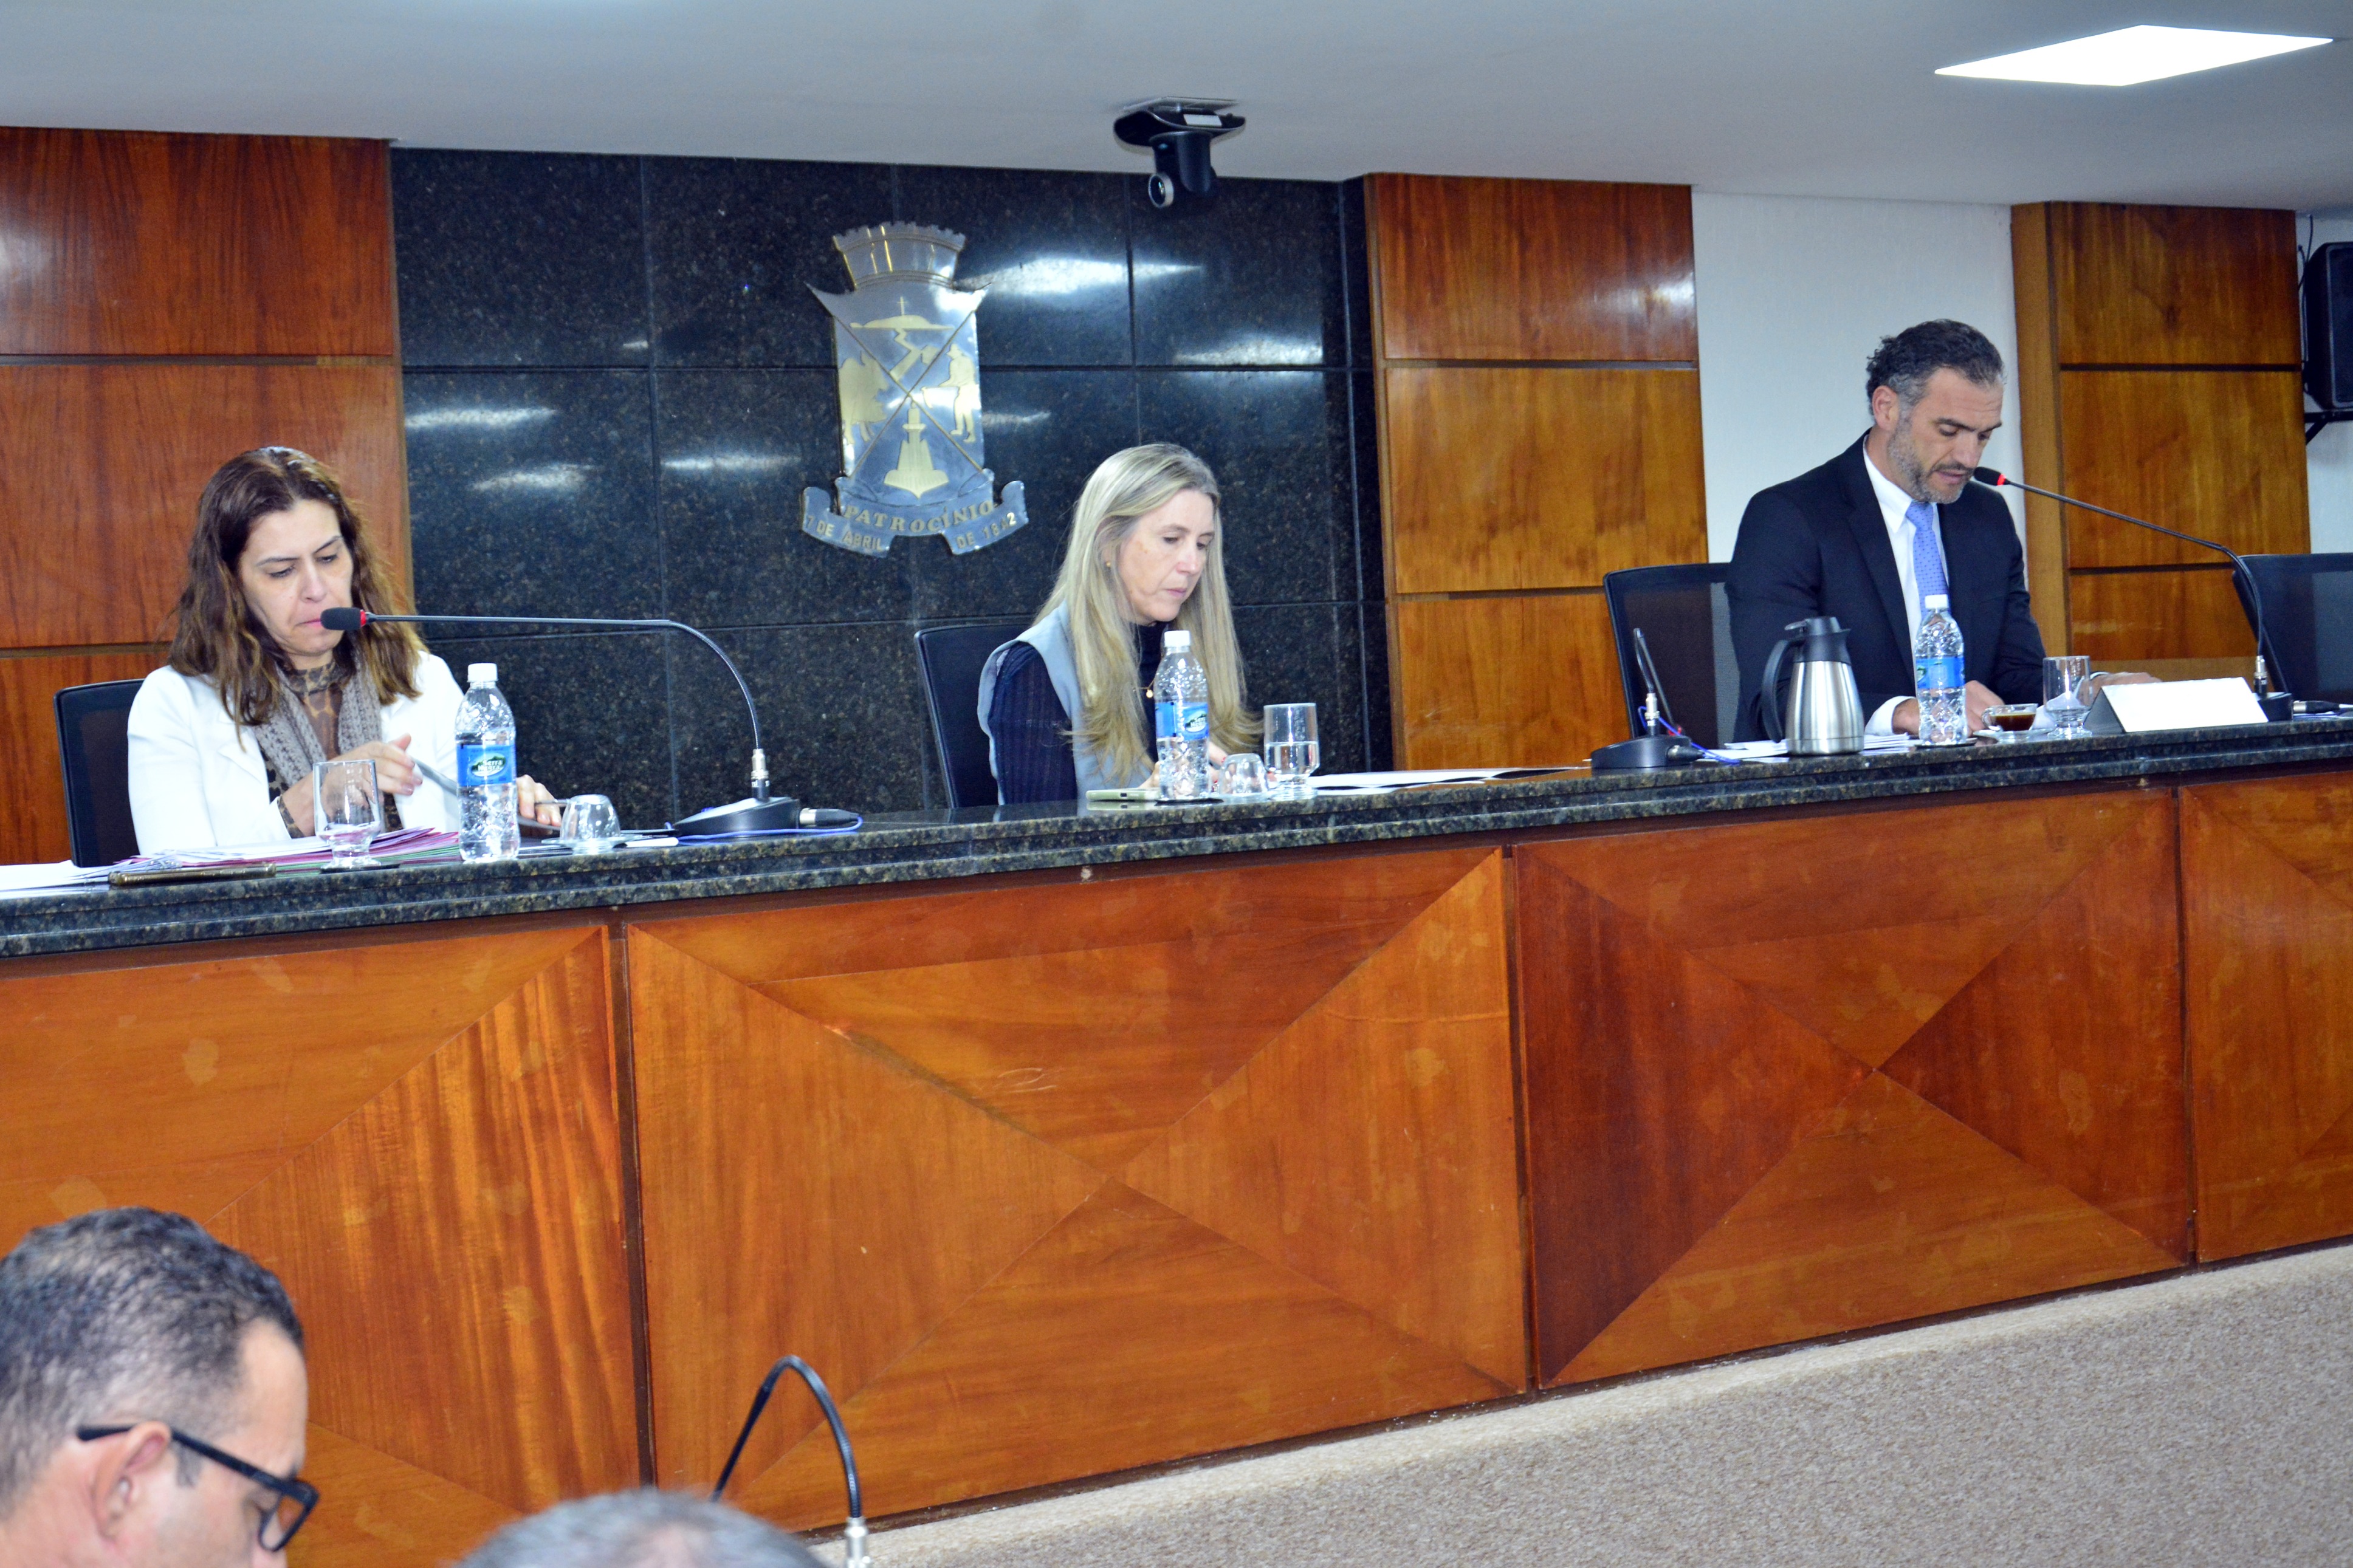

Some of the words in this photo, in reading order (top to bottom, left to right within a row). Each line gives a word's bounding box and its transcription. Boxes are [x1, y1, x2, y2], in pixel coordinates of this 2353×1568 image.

[843, 499, 993, 532] PATROCÍNIO
[806, 515, 814, 529] 7
[816, 519, 834, 537] DE
[842, 530, 883, 552] ABRIL
[956, 532, 975, 549] DE
